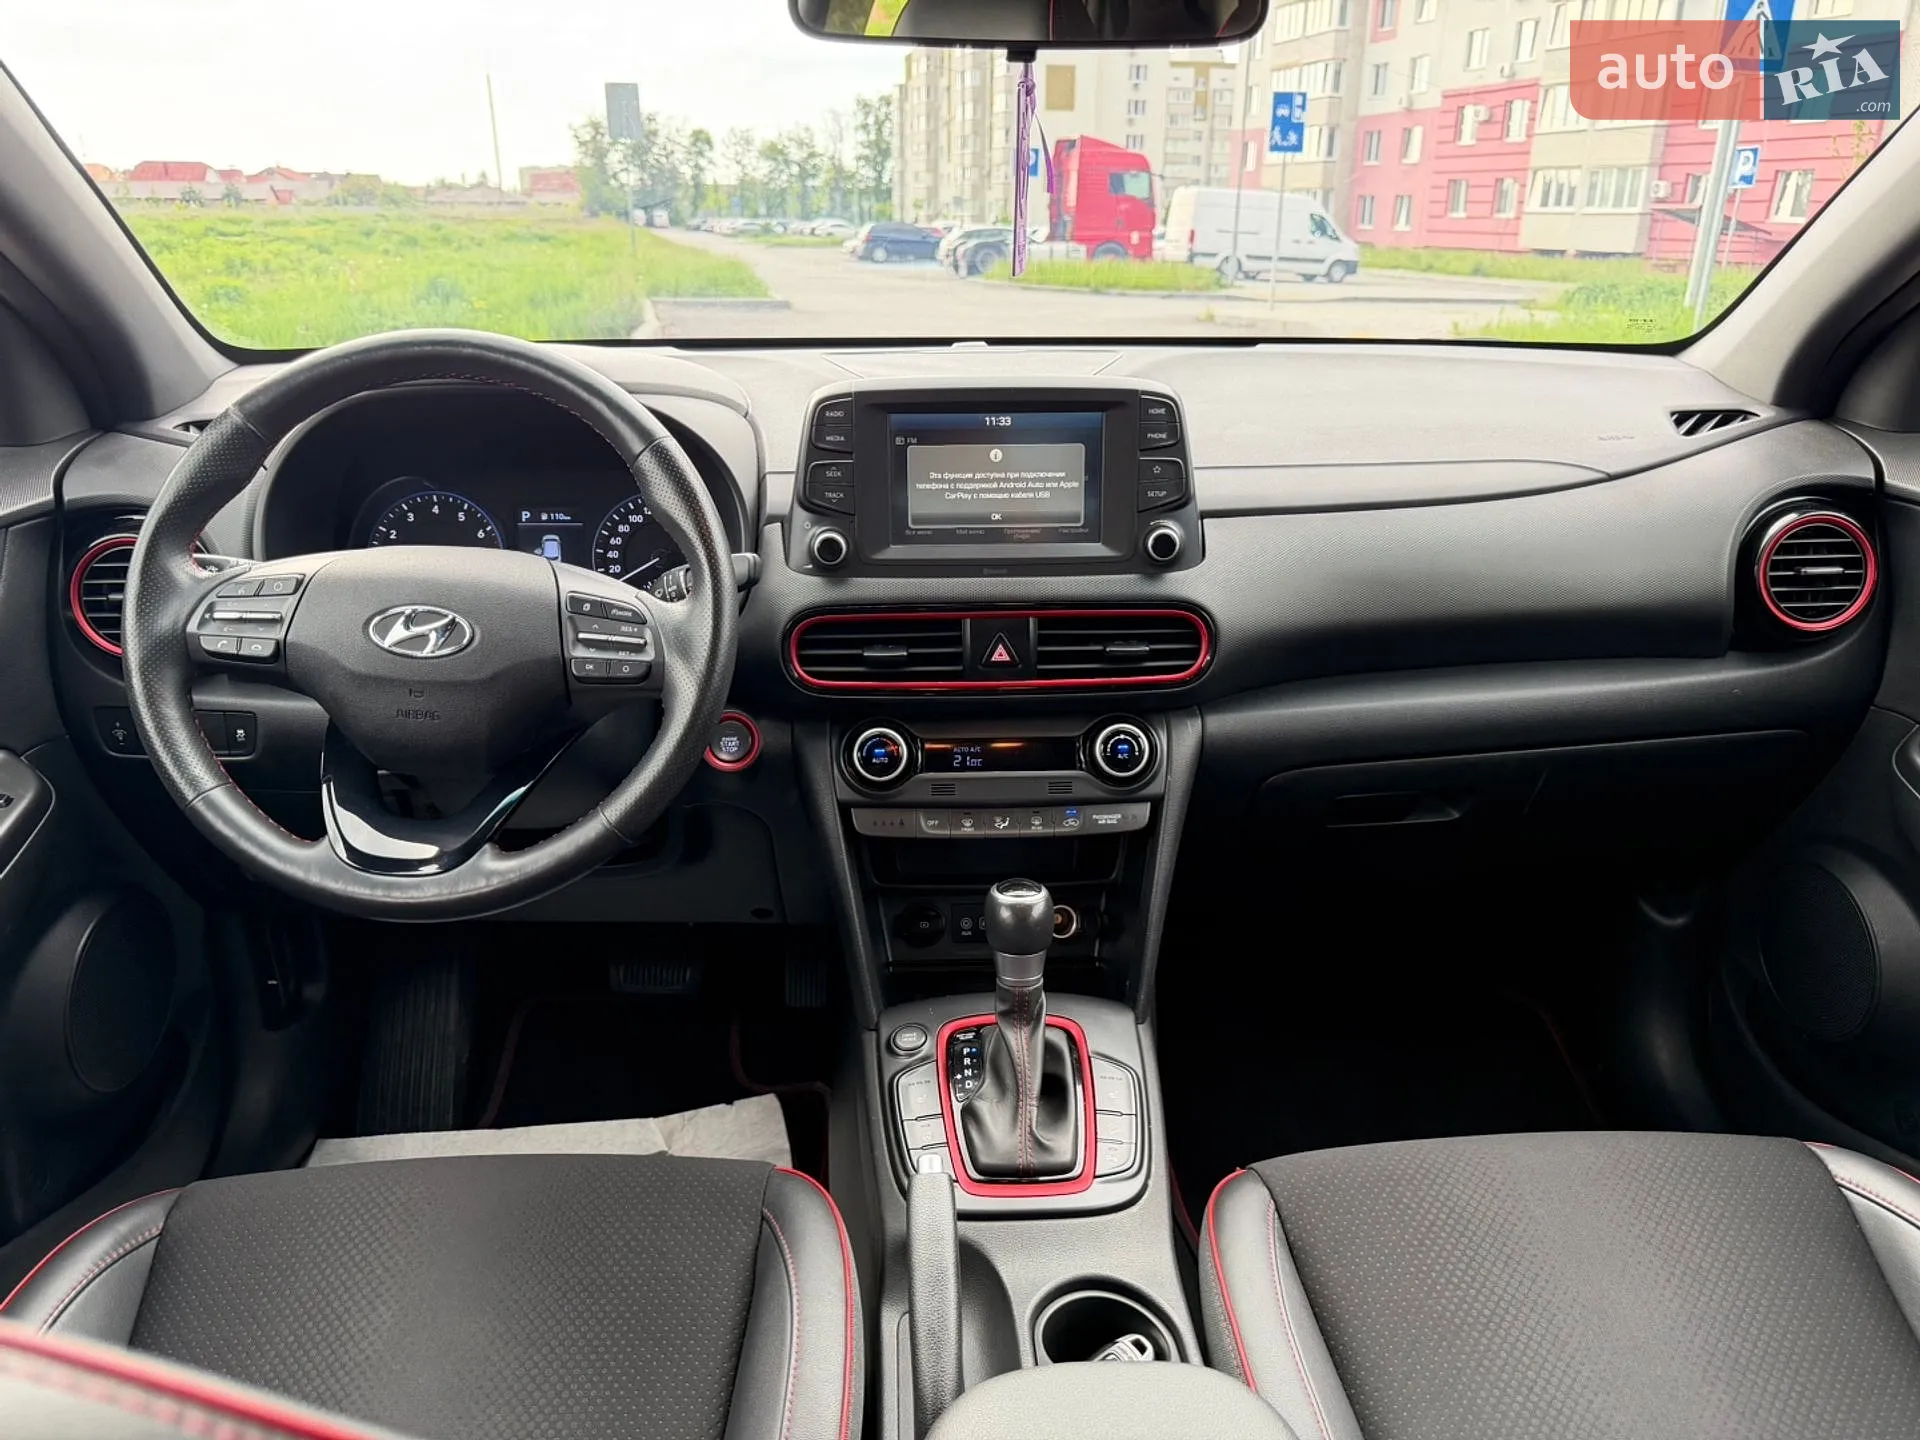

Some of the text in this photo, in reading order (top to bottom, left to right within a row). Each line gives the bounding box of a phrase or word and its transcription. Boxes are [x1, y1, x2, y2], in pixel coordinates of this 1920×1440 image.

[985, 416, 1012, 426] 11:33
[999, 481, 1026, 489] Android
[1027, 481, 1044, 489] Auto
[1059, 481, 1079, 490] Apple
[944, 491, 971, 500] CarPlay
[1035, 490, 1050, 499] USB
[432, 505, 439, 514] 4
[407, 513, 414, 522] 3
[458, 512, 465, 521] 5
[521, 511, 530, 522] P
[628, 515, 643, 523] 100
[618, 524, 630, 532] 80
[389, 530, 397, 539] 2
[477, 529, 485, 538] 6
[609, 537, 622, 545] 60
[607, 551, 619, 559] 40
[609, 565, 620, 573] 20
[395, 708, 440, 720] AIRBAG
[964, 1068, 972, 1077] N
[965, 1080, 973, 1088] D
